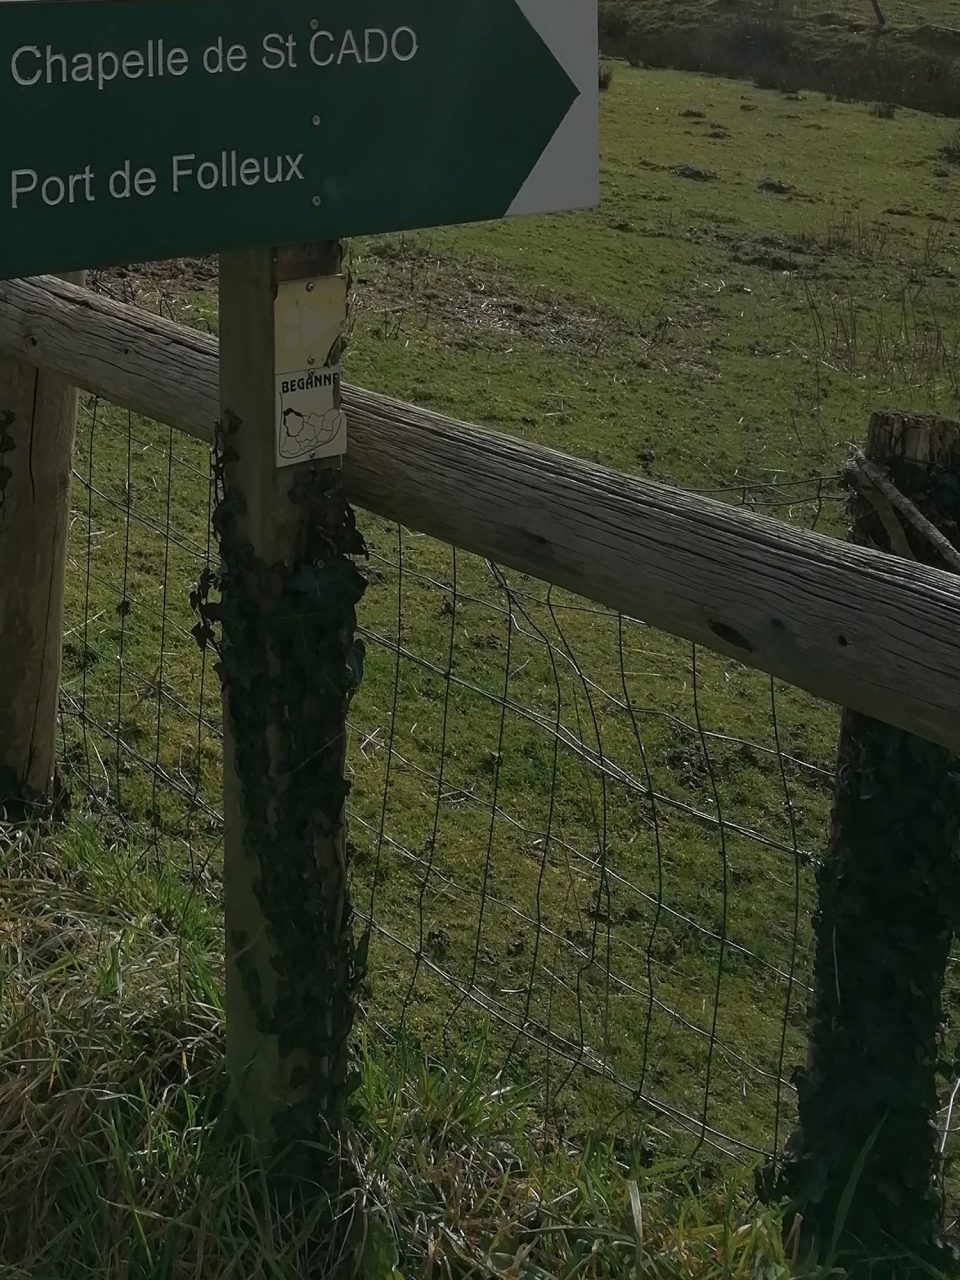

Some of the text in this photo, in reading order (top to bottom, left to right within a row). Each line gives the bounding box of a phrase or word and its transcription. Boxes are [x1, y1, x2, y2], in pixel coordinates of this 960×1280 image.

[11, 26, 420, 90] Chapelle de St CADO
[11, 150, 305, 209] Port de Folleux
